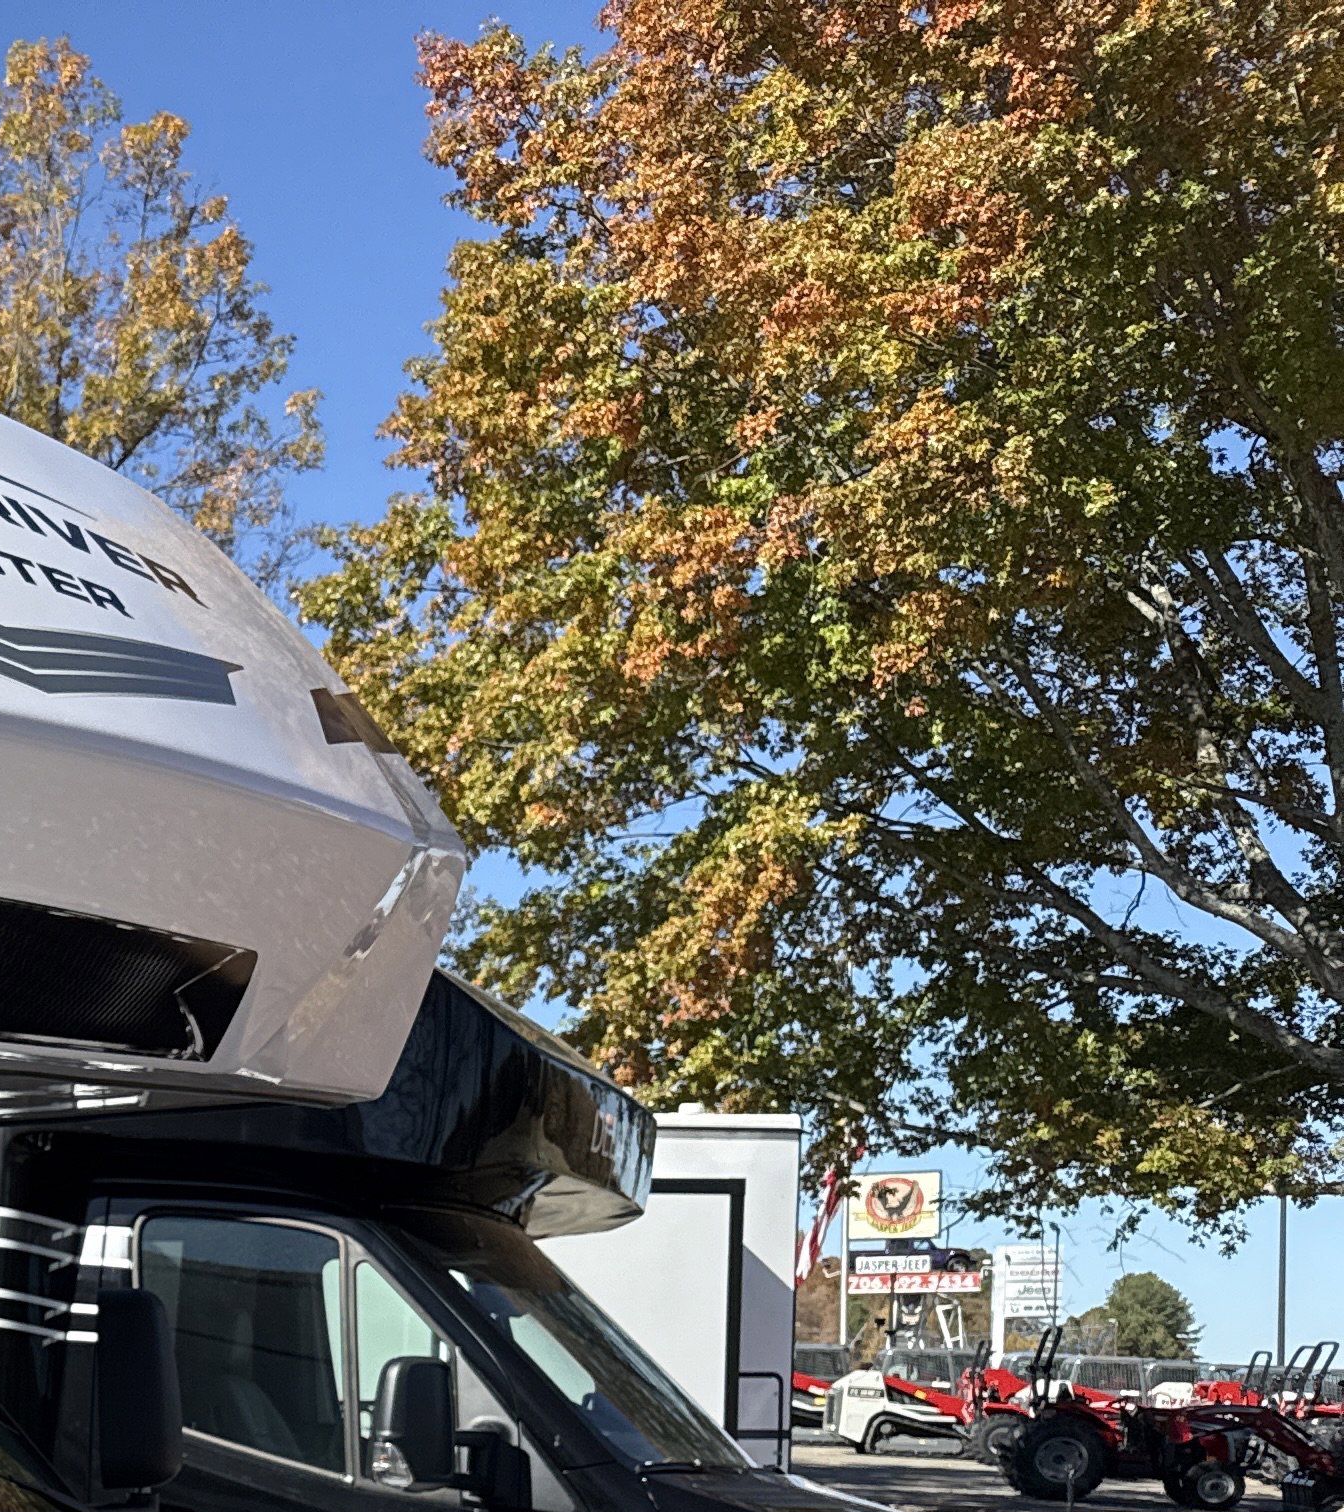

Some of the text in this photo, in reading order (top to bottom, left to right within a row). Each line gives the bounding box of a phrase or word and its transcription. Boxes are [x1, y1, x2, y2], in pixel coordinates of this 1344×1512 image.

[858, 1258, 928, 1273] JASPER JEEP
[1018, 1285, 1051, 1295] Jeep
